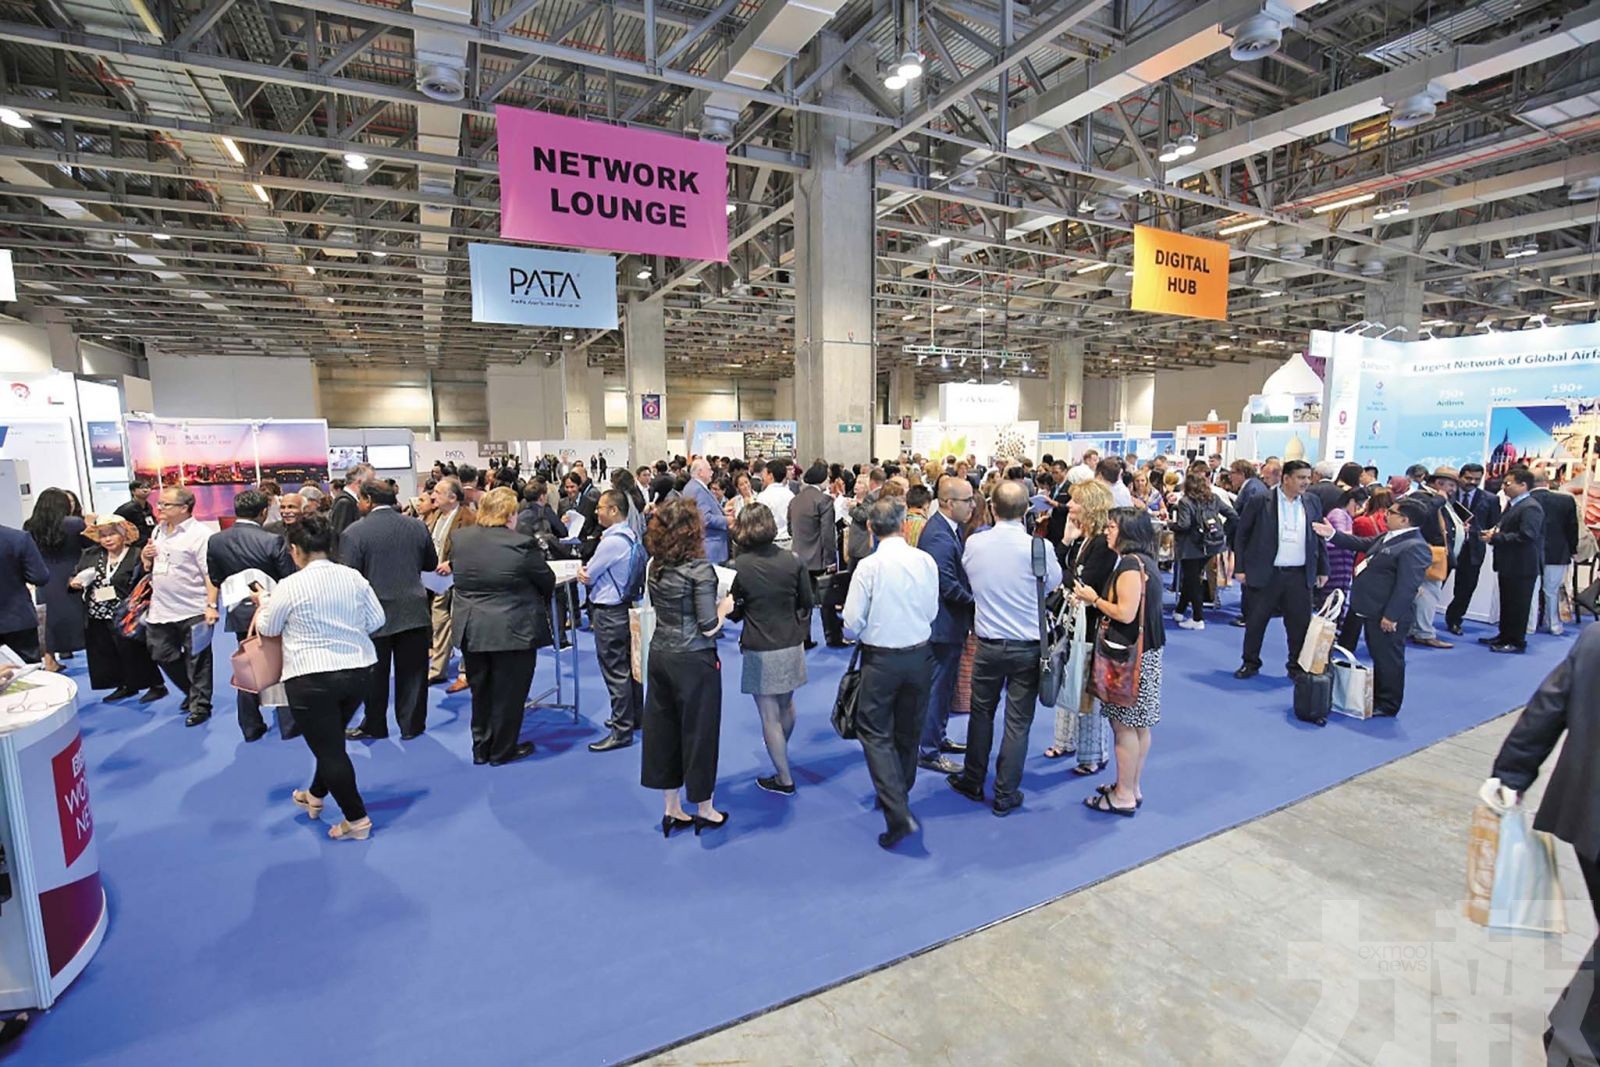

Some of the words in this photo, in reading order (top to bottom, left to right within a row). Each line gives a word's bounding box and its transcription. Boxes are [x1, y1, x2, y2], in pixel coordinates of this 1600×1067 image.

[533, 145, 700, 194] NETWORK
[551, 188, 687, 229] LOUNGE
[1155, 249, 1209, 274] DIGITAL
[510, 267, 581, 300] PATA
[1168, 276, 1197, 294] HUB
[1454, 356, 1505, 370] Network
[1508, 354, 1521, 366] of
[1524, 352, 1567, 365] Global
